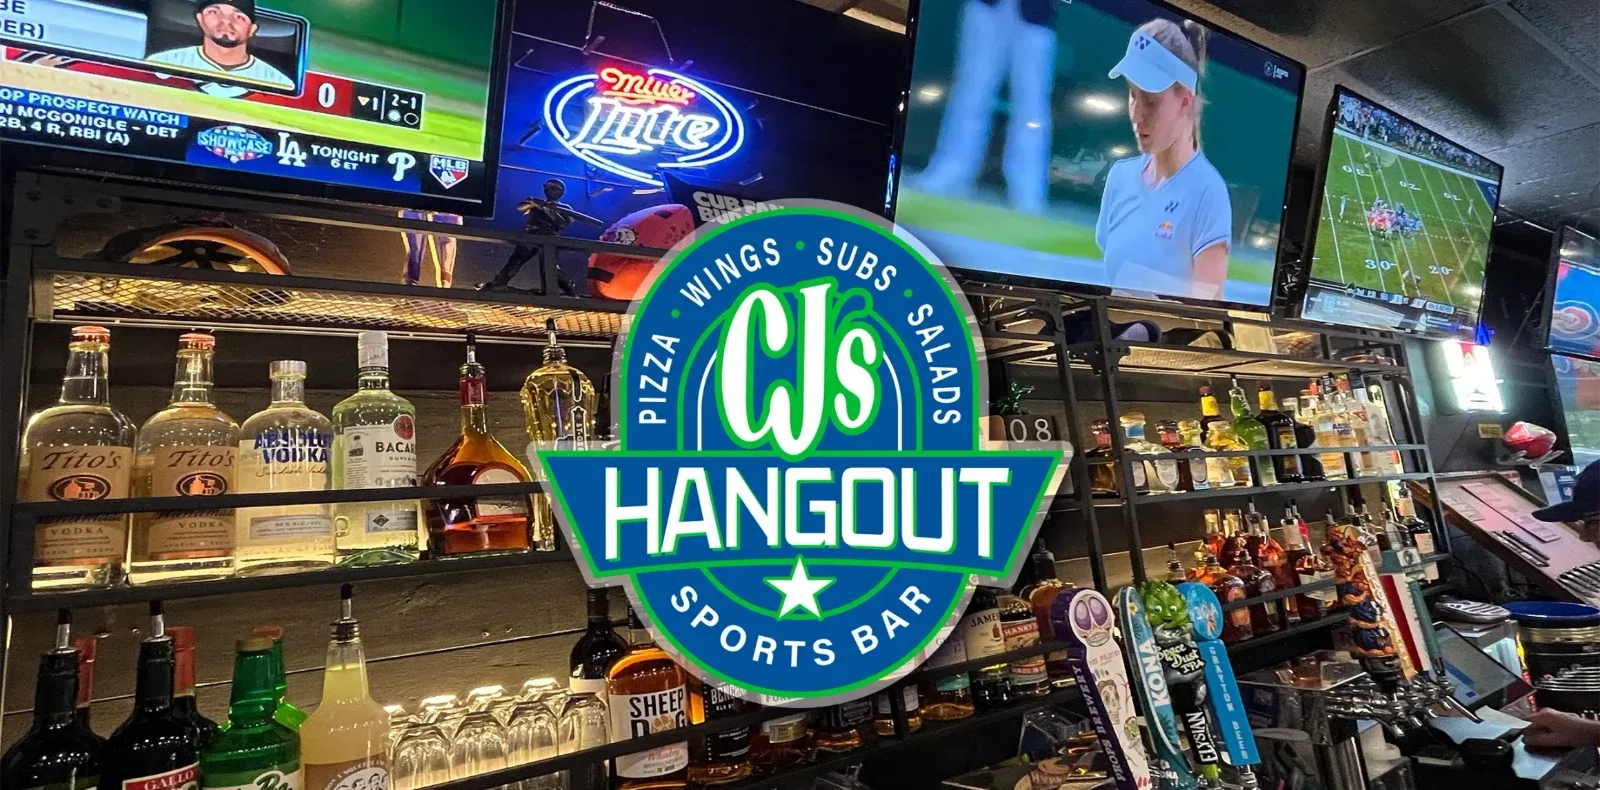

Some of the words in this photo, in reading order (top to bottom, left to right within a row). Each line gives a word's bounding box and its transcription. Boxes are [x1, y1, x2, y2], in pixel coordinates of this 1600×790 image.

[0, 19, 44, 40] ER)
[601, 67, 695, 101] Miller
[318, 82, 336, 108] 0
[391, 93, 416, 110] 2-1
[29, 92, 119, 117] PROSPECT
[122, 107, 180, 126] WATCH
[18, 105, 127, 131] MCGONIGLE
[146, 125, 179, 138] DET
[569, 97, 720, 151] Lite
[31, 121, 42, 132] 4
[47, 123, 65, 137] R,
[70, 127, 100, 140] RBI
[105, 131, 130, 146] (A)
[199, 132, 272, 154] SHOWCASE
[276, 131, 307, 167] LA
[311, 144, 379, 164] TONIGHT
[330, 158, 341, 168] 6
[344, 162, 359, 170] ET
[387, 152, 416, 182] P
[433, 157, 467, 170] MLB
[693, 191, 741, 212] CUB
[254, 432, 332, 449] ABSOLUT
[42, 450, 121, 470] Tito's
[168, 449, 234, 468] Tito's
[263, 447, 328, 464] VODKA
[51, 527, 104, 536] VODKA
[178, 521, 224, 529] VODKA
[1171, 648, 1200, 668] Dust
[1181, 660, 1205, 673] IPA
[1138, 638, 1171, 707] KONA
[629, 688, 684, 718] SHEEP
[1072, 664, 1106, 735] BREWERY
[1209, 647, 1234, 712] GRAYTON
[1232, 721, 1249, 759] BEER
[1186, 711, 1218, 762] ELYSIAN
[144, 770, 194, 790] GALLO
